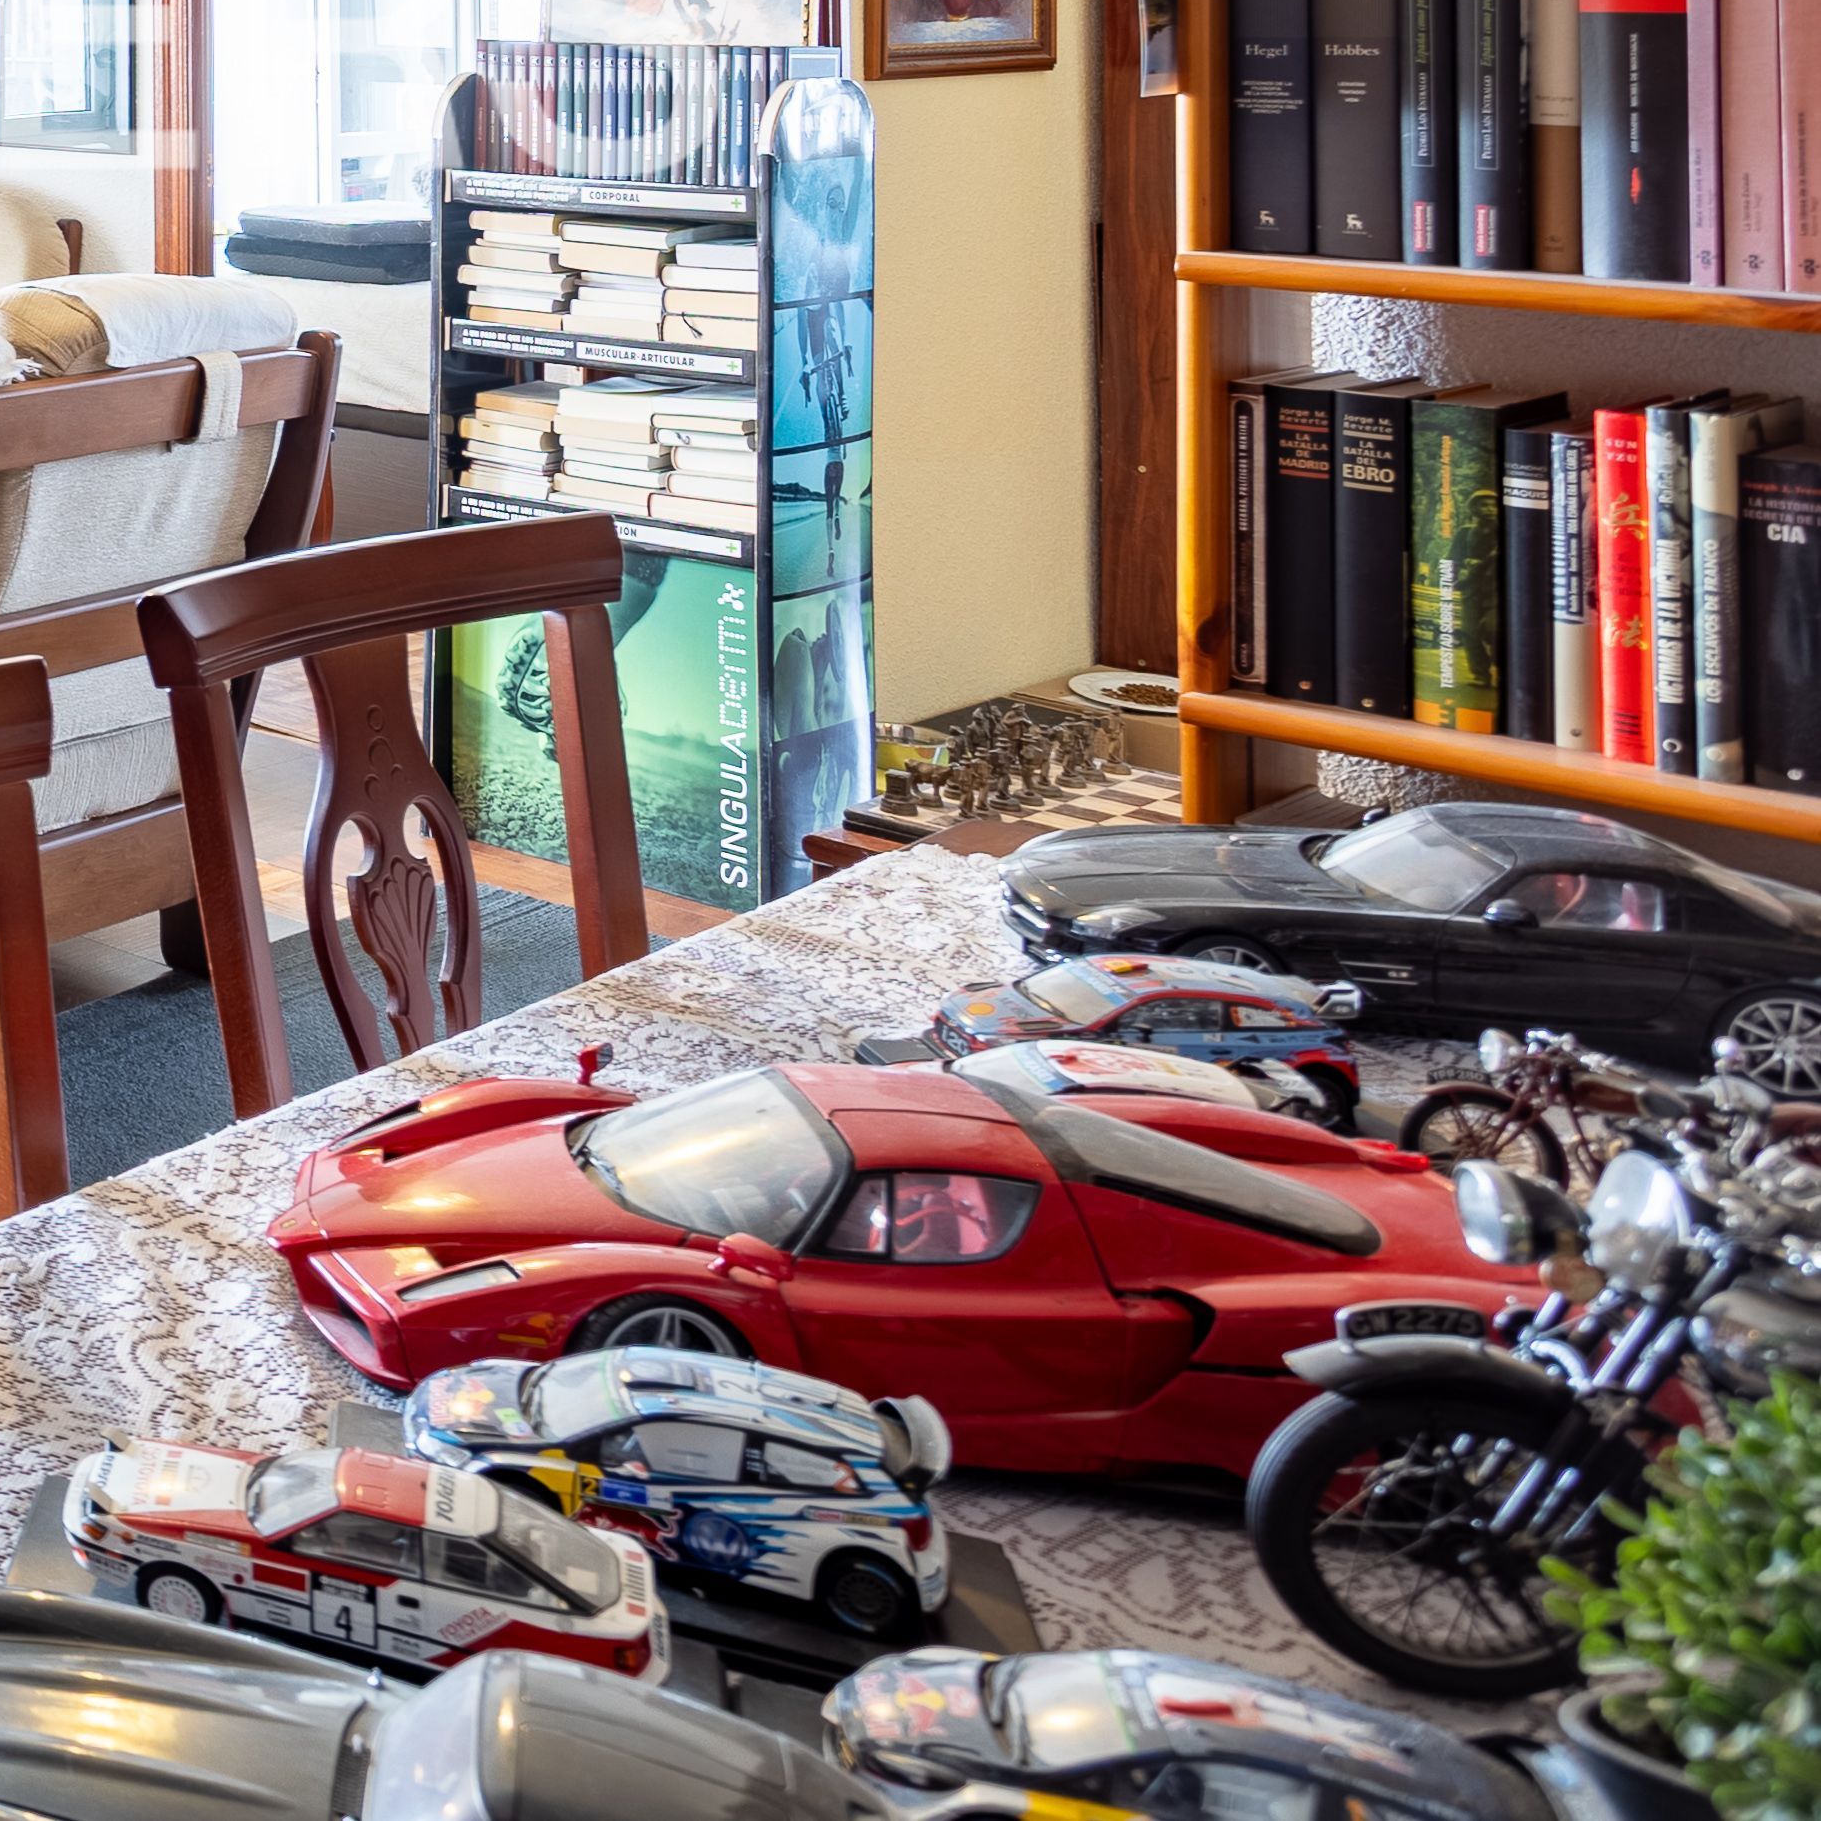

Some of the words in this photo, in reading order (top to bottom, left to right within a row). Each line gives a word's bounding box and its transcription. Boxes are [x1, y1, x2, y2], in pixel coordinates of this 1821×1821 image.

[1245, 44, 1288, 59] Hegel
[1325, 44, 1380, 57] Hobbes
[589, 190, 641, 203] CORPORAL
[585, 346, 695, 367] MUSCULAR-ARTICULAR
[1279, 439, 1328, 451] BATALLA
[1295, 433, 1310, 442] LA
[1359, 440, 1374, 449] LA
[1605, 437, 1638, 450] SUN
[1295, 450, 1310, 458] DE
[1343, 446, 1391, 460] BATALLA
[1356, 457, 1377, 466] DEL
[1606, 452, 1638, 464] TZU
[1279, 457, 1330, 471] MADRID
[1342, 464, 1395, 483] EBRO
[1767, 523, 1807, 545] CIA
[1656, 539, 1682, 598] VICTORIA
[1703, 539, 1718, 592] FRANCO
[1440, 559, 1454, 600] VIETNAM
[1656, 602, 1682, 618] LA
[1704, 594, 1719, 611] DE
[1440, 602, 1454, 633] SOBRE
[1657, 620, 1683, 637] DE
[1704, 614, 1722, 676] ESCLAVOS
[1440, 634, 1454, 689] TEMPESTAD
[1654, 638, 1684, 703] VÍCTIMAS
[1704, 678, 1722, 703] LOS
[333, 1603, 355, 1640] 4
[438, 1606, 491, 1641] TOYOTA
